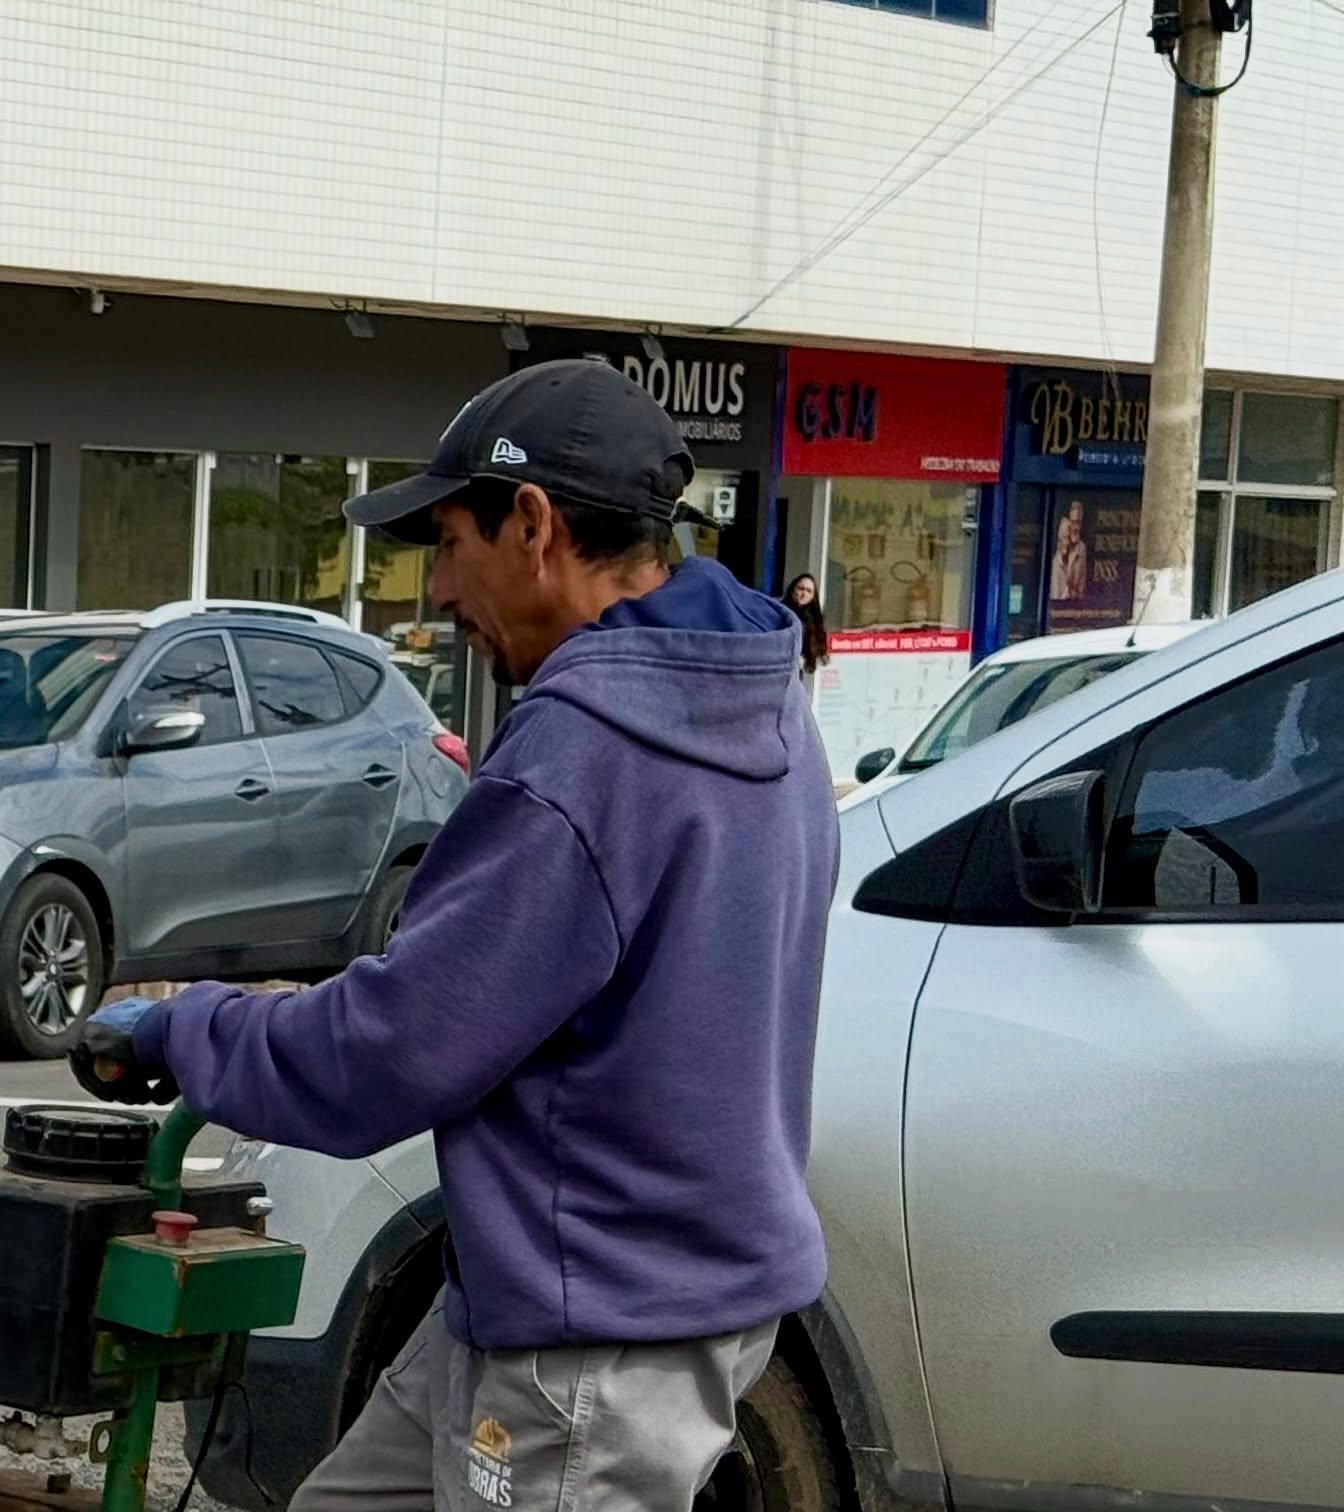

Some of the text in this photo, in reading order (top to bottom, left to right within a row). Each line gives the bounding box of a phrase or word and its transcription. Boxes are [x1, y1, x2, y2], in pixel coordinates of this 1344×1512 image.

[623, 355, 745, 415] DOMUS
[676, 416, 743, 441] MOBILIÁRIOS
[1077, 396, 1148, 442] BEHR
